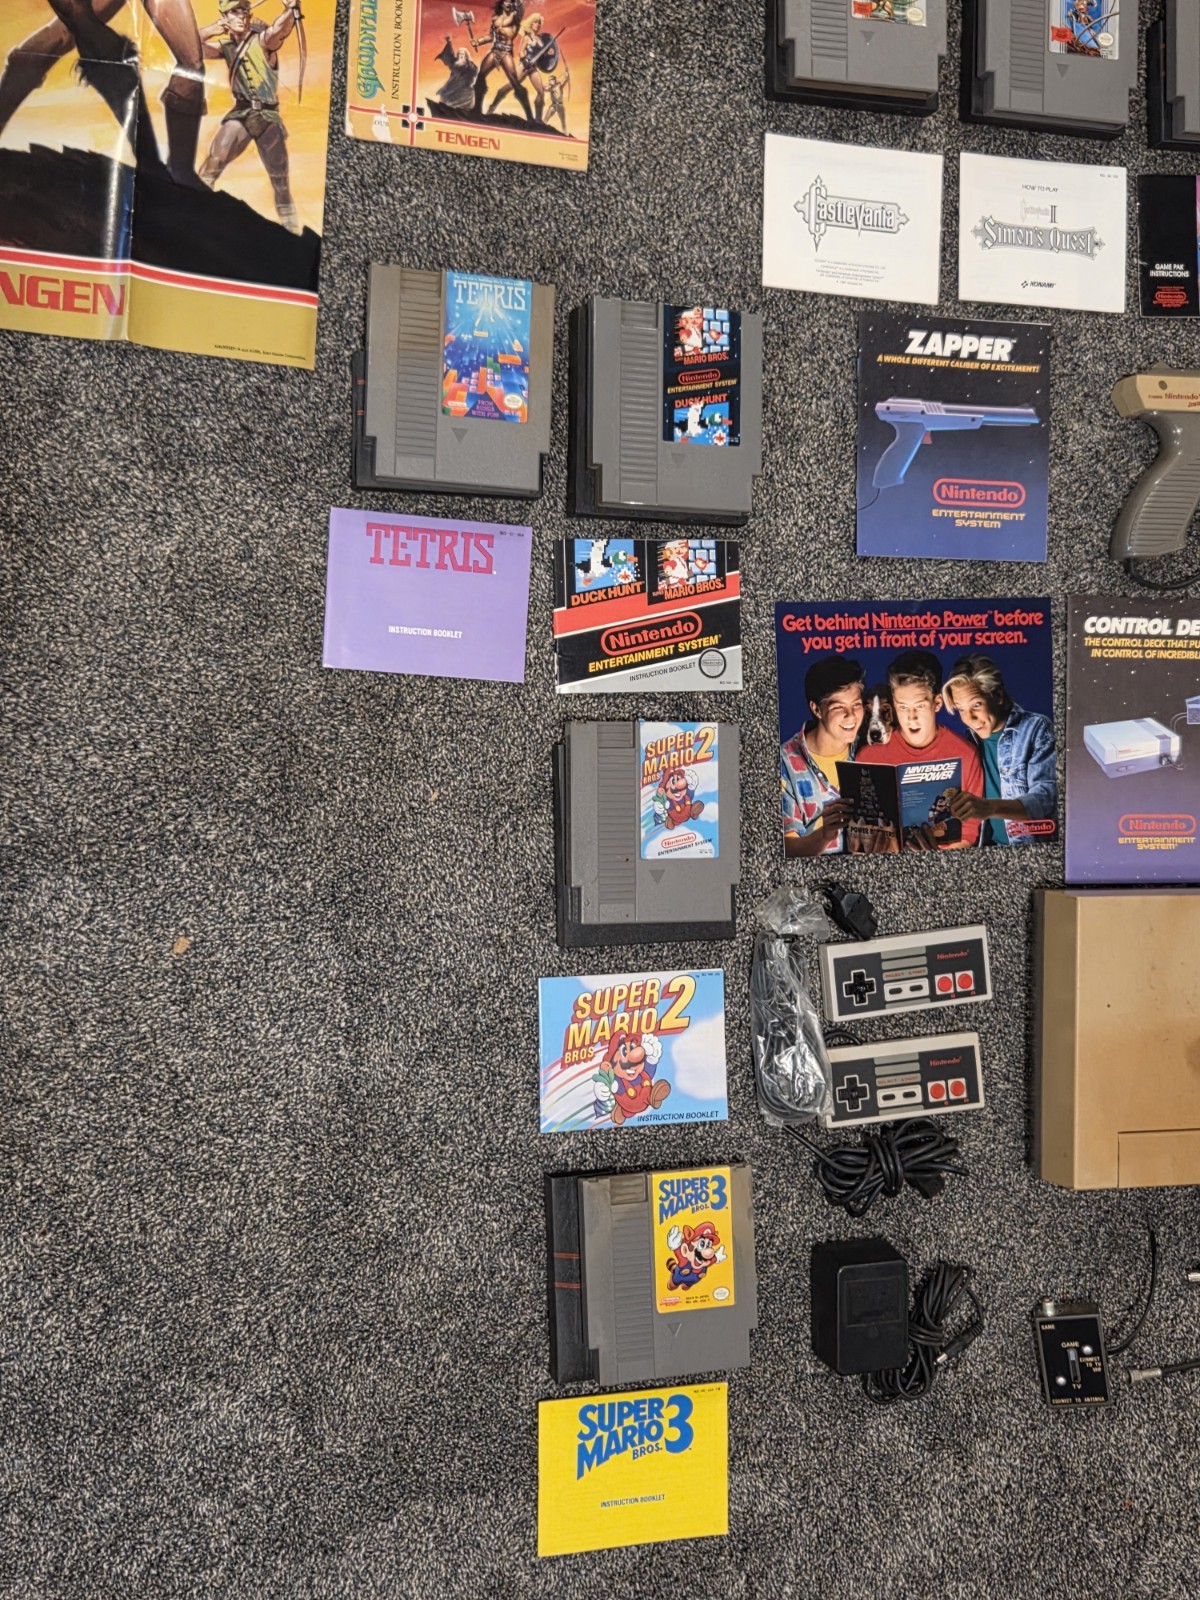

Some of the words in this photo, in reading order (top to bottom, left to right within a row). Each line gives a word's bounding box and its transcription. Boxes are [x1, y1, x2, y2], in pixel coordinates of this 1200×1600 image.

[391, 33, 402, 100] INSTRUCTION
[435, 130, 500, 150] TENGEN
[984, 216, 1044, 248] Simon's
[1050, 227, 1092, 253] Quest
[453, 279, 526, 311] TETRIS
[904, 329, 1015, 362] ZAPPER
[684, 355, 707, 365] MARIO
[707, 351, 729, 362] BROS.
[884, 355, 910, 365] WHOLE
[911, 358, 950, 368] DIFFERENT
[950, 360, 980, 370] CALIBER
[980, 363, 991, 371] OF
[991, 364, 1041, 373] EXCITEMENT!
[667, 382, 713, 394] ENTERTAINMENT
[714, 378, 737, 388] SYSTEM
[681, 372, 718, 382] Nintendo
[675, 397, 701, 408] DUCK
[701, 392, 728, 404] HUNT
[941, 484, 1019, 502] Nintendo
[932, 509, 1026, 520] ENTERTAINMENT
[955, 519, 1001, 528] SYSTEM
[366, 522, 495, 575] TETRIS
[571, 591, 606, 607] DUCK
[607, 583, 642, 598] HUNT
[664, 584, 695, 600] MARIO
[696, 578, 725, 594] BROS.
[782, 614, 812, 632] Get
[814, 612, 869, 631] behind
[873, 611, 941, 629] Nintendo
[993, 609, 1044, 626] before
[1084, 616, 1173, 635] CONTROL
[388, 626, 432, 636] INSTRUCTION
[433, 628, 463, 639] BOOKLET
[608, 619, 695, 650] Nintendo
[801, 634, 832, 653] you
[834, 631, 861, 652] get
[863, 631, 877, 648] in
[879, 630, 916, 647] front
[919, 630, 937, 647] of
[938, 631, 973, 649] your
[974, 630, 1028, 646] screen.
[1084, 637, 1101, 647] THE
[1101, 638, 1143, 648] CONTROL
[1143, 639, 1165, 648] DECK
[1167, 639, 1189, 648] THAT
[588, 644, 674, 673] ENTERTAINMENT
[678, 635, 720, 652] SYSTEM
[1090, 649, 1102, 658] IN
[1102, 649, 1143, 659] CONTROL
[1144, 650, 1157, 659] OF
[629, 667, 668, 682] INSTRUCTION
[668, 661, 696, 673] BOOKLET
[645, 730, 695, 759] SUPER
[695, 726, 716, 763] 2
[643, 747, 695, 776] MARIO
[904, 762, 953, 774] NINTENDO
[919, 771, 955, 783] POWER
[1129, 819, 1187, 830] Nintendo
[657, 844, 694, 856] ENTERTAINMENT
[663, 835, 694, 847] Nintendo
[936, 951, 968, 960] Nintendo
[573, 978, 661, 1020] SUPER
[659, 974, 697, 1032] 2
[565, 1007, 658, 1051] MARIO
[930, 1058, 961, 1066] Nintendo
[637, 1112, 685, 1123] INSTRUCTION
[685, 1110, 719, 1120] BOOKLET
[659, 1176, 710, 1202] SUPER
[710, 1174, 727, 1210] 3
[659, 1189, 710, 1225] MARIO
[691, 1203, 710, 1214] BROS.
[577, 1397, 665, 1441] SUPER
[664, 1394, 694, 1454] 3
[576, 1419, 664, 1481] MARIO
[632, 1442, 663, 1461] BROS.
[600, 1497, 639, 1508] INSTRUCTION
[639, 1494, 666, 1503] BOOKLET
